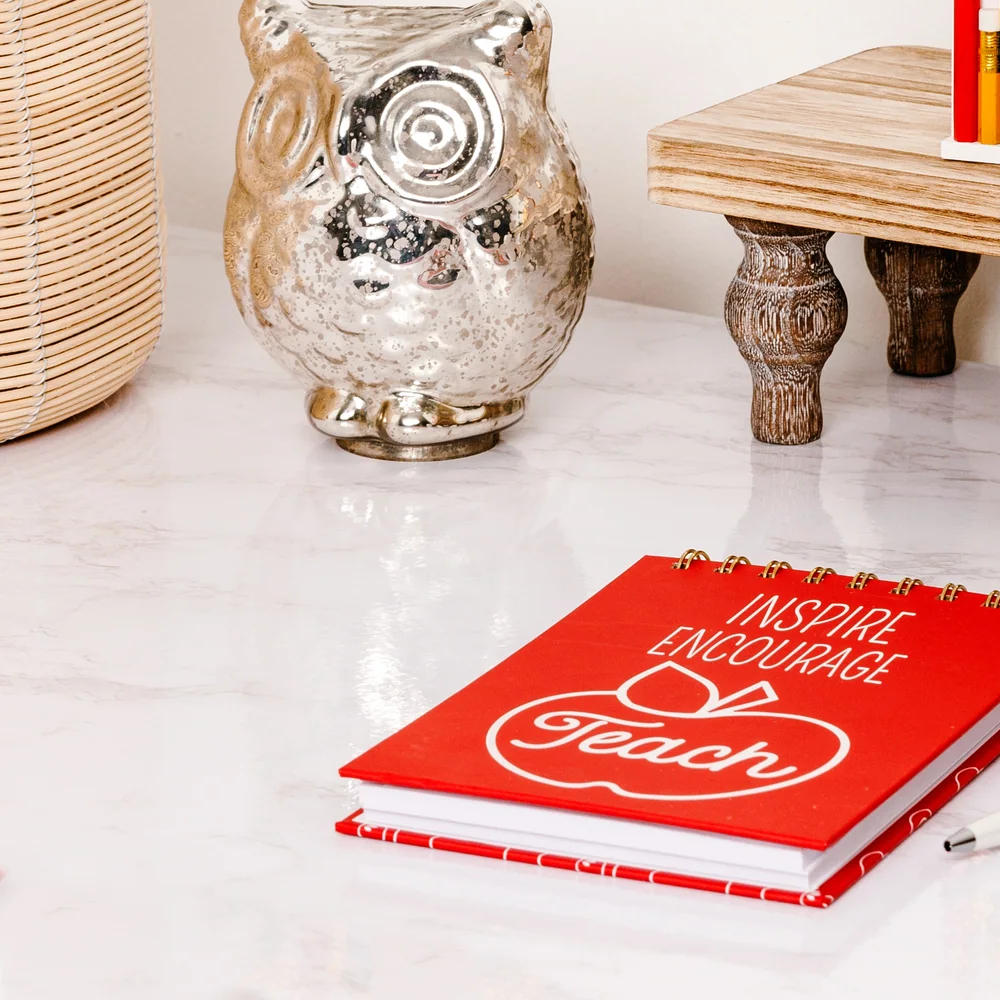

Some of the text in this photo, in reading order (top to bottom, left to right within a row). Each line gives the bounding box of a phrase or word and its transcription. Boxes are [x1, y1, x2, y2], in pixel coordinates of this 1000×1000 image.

[725, 592, 917, 646] INSPIRE
[646, 625, 909, 686] ENCOURAGE
[510, 710, 798, 779] Teach
